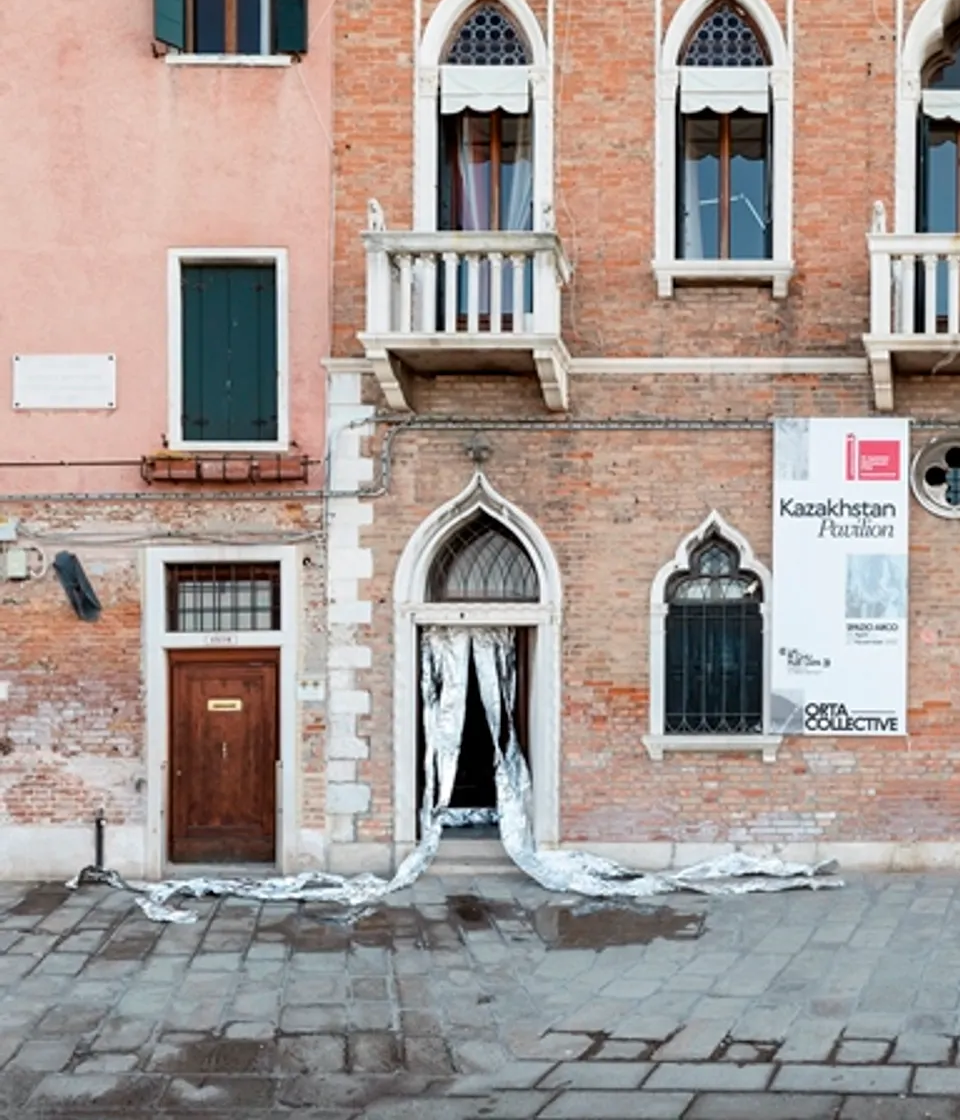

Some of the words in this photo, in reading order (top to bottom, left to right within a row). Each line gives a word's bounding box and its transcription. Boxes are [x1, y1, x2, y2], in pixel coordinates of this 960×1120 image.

[779, 497, 897, 518] Kazakhstan
[817, 517, 895, 538] Pavilion
[804, 702, 849, 717] ORTA
[804, 716, 899, 731] COLLECTIVE
